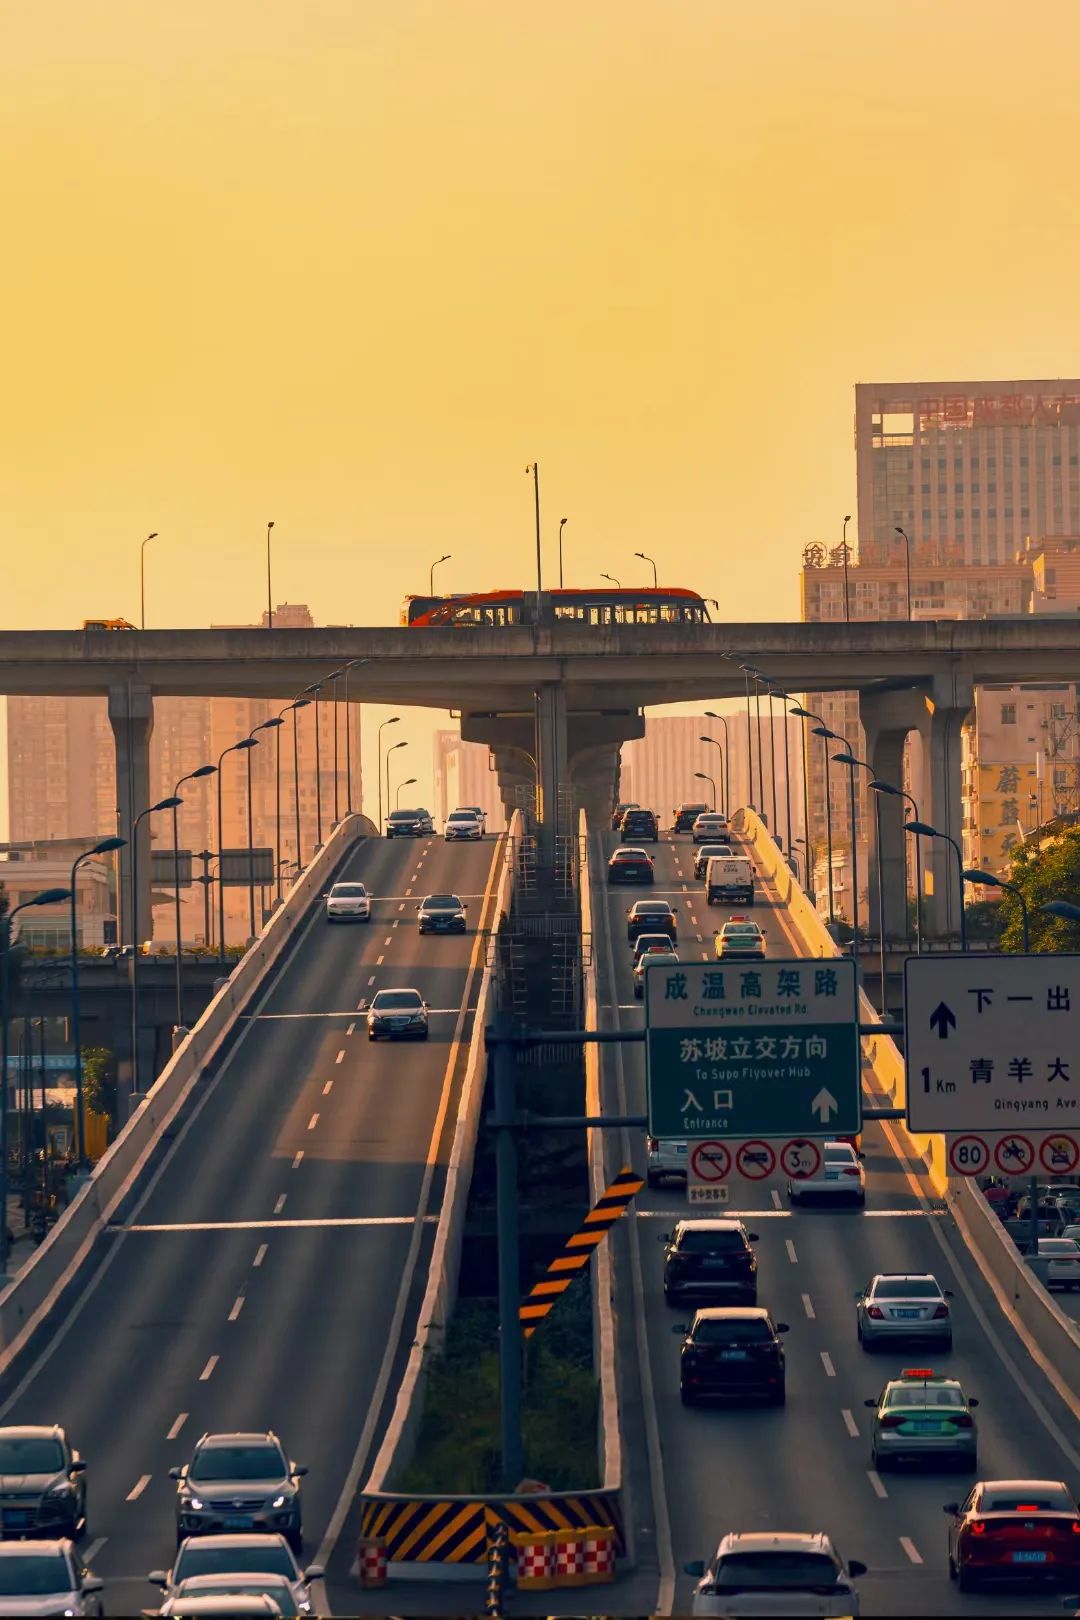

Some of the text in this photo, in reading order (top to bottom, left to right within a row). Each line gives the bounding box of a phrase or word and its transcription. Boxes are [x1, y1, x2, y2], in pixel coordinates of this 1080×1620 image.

[664, 968, 838, 1001] 成温高架路
[747, 1003, 792, 1016] Elevated
[967, 984, 1071, 1014] 下一出
[679, 1034, 828, 1063] 苏坡立交方向
[696, 1065, 811, 1081] To Supo Flyover Hub
[968, 1056, 1071, 1085] 青羊大
[680, 1087, 734, 1113] 入口
[993, 1097, 1049, 1112] Qingyang
[683, 1117, 729, 1129] Entrance
[958, 1145, 981, 1164] 80
